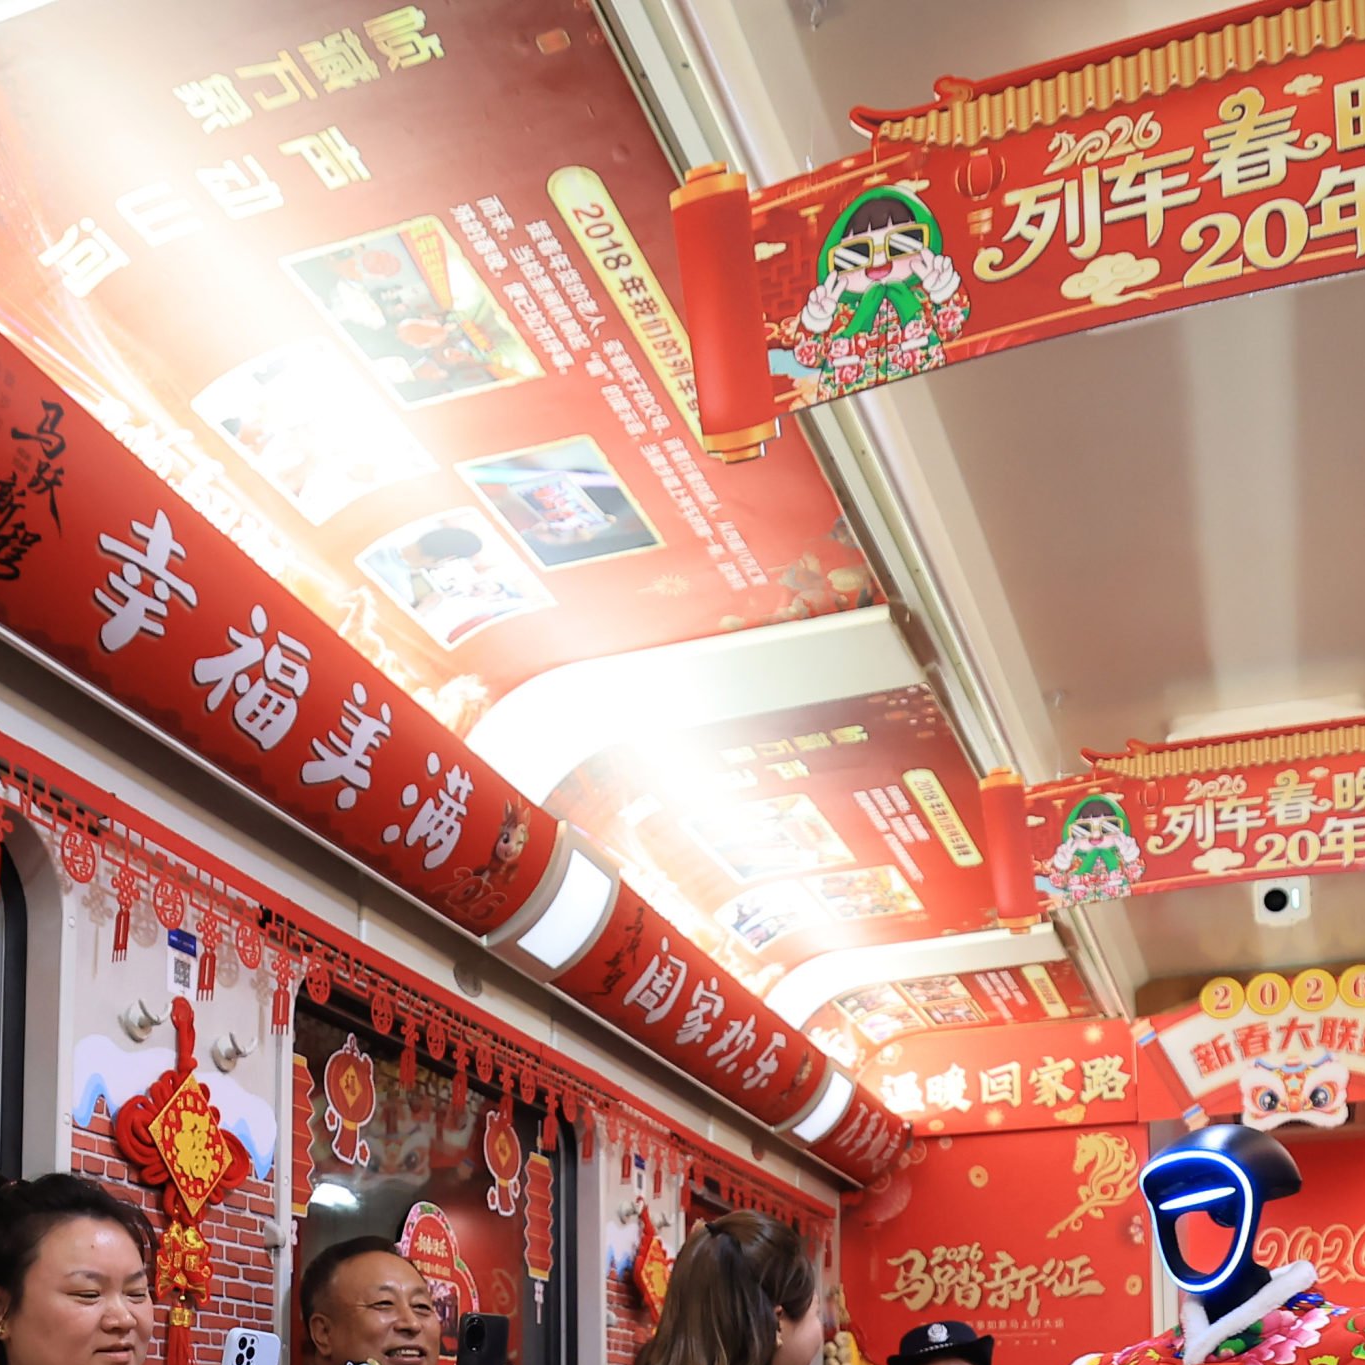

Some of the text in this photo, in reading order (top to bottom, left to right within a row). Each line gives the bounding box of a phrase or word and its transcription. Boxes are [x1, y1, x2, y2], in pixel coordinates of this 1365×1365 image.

[1045, 109, 1163, 176] 2026
[573, 203, 633, 271] 2018
[92, 508, 473, 872] 幸福美满
[879, 1054, 1133, 1113] 温暖回家路
[881, 1249, 1106, 1317] 马踏新征
[931, 1242, 984, 1264] 2026
